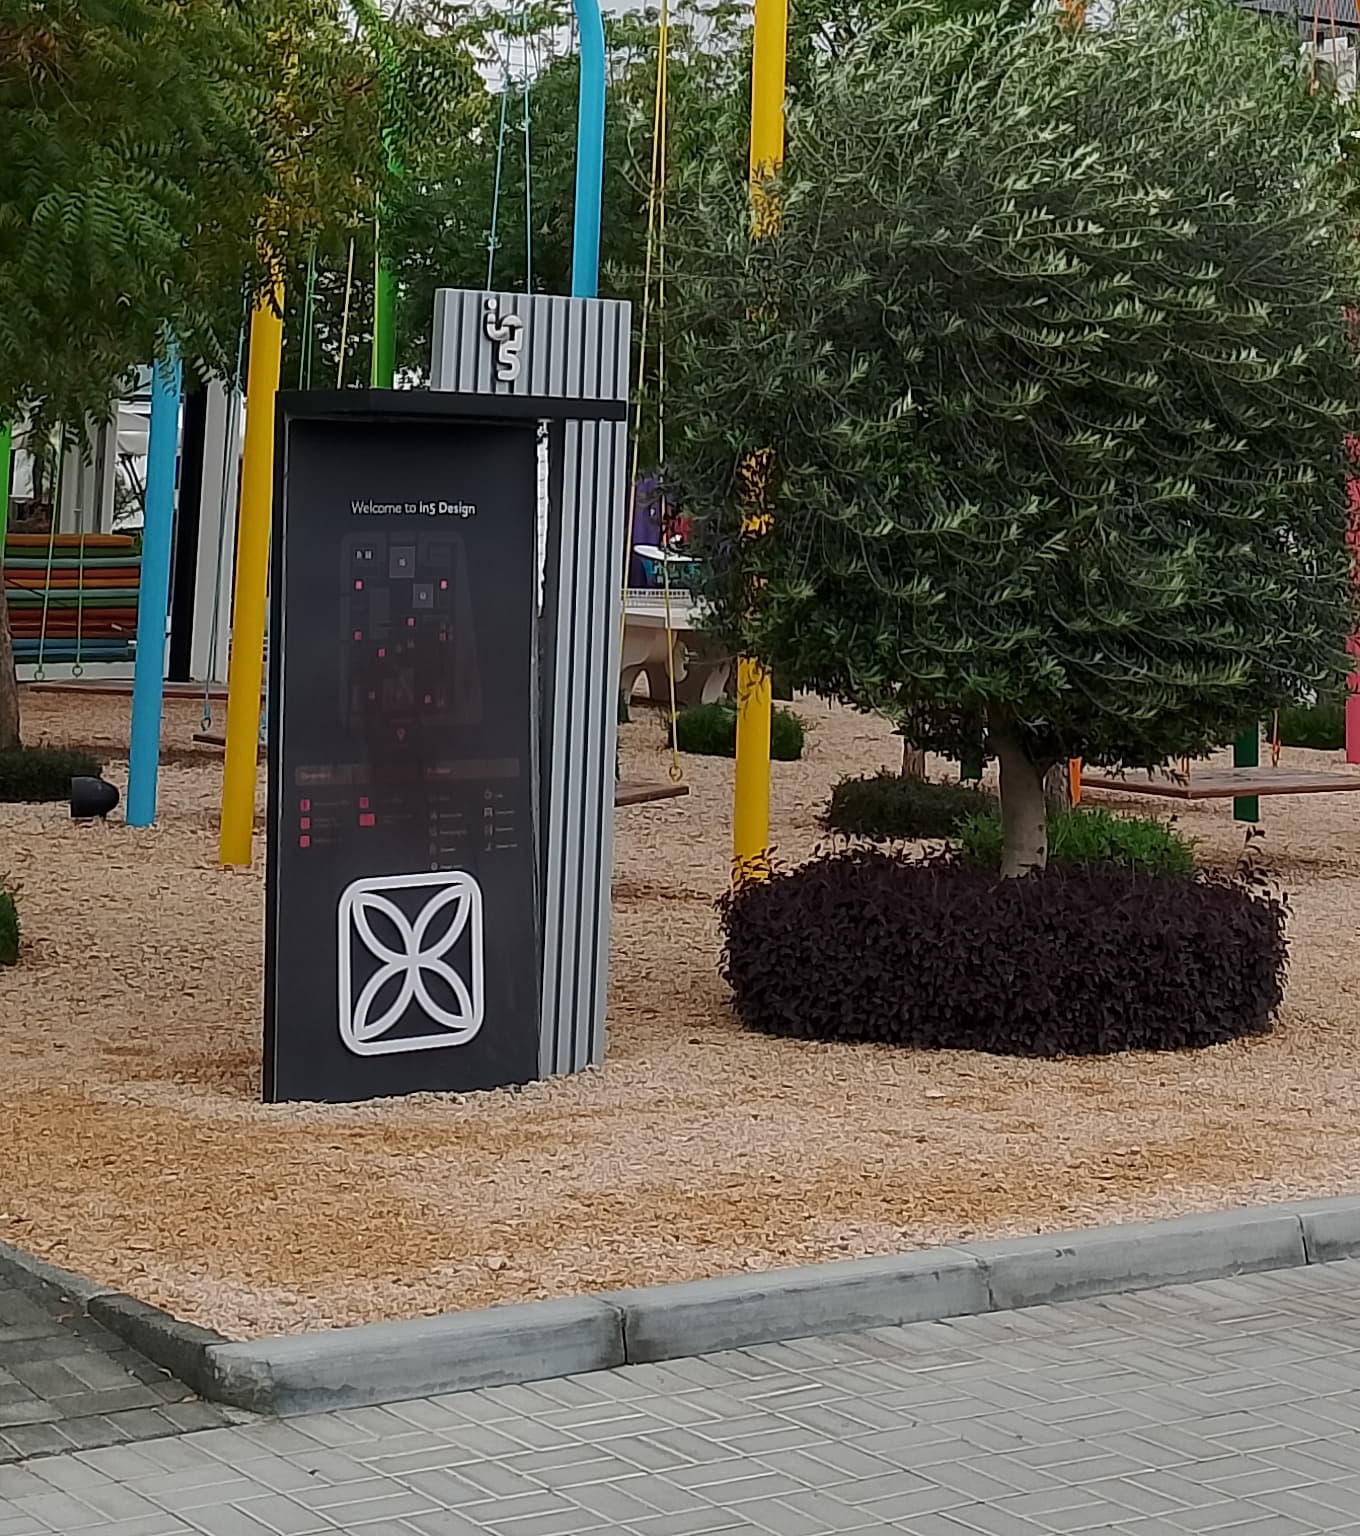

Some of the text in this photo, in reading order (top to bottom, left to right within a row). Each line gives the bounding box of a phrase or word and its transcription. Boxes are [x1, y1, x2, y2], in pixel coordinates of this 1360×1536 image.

[351, 500, 476, 518] Welcome to in5 Design
